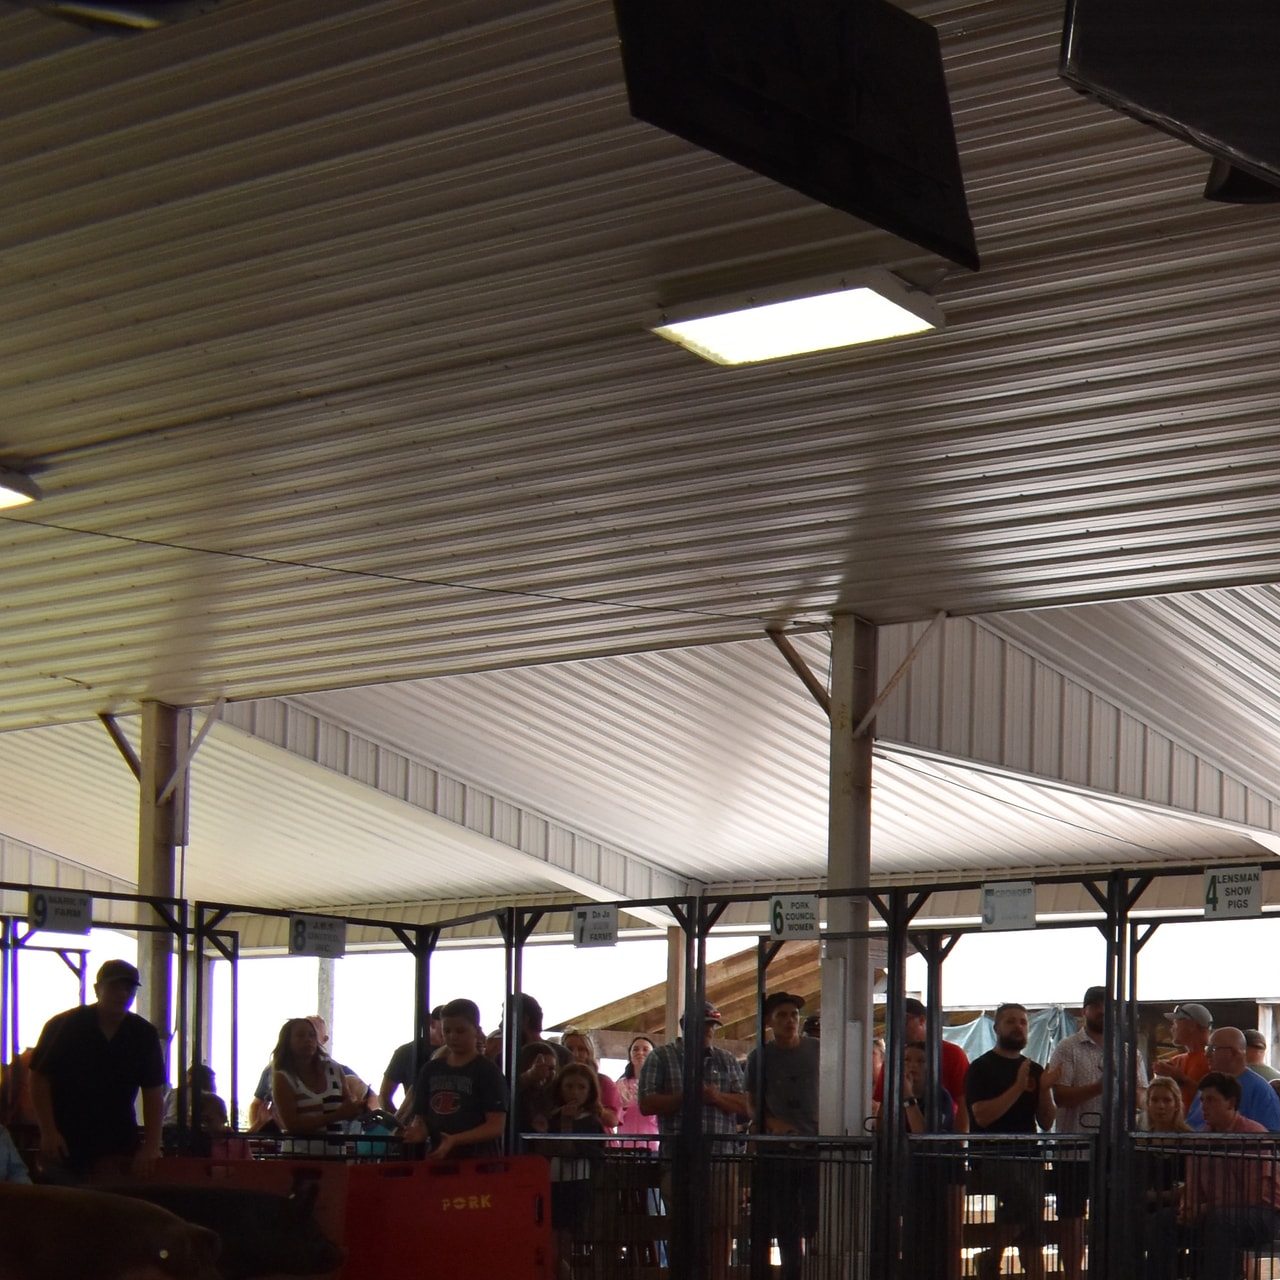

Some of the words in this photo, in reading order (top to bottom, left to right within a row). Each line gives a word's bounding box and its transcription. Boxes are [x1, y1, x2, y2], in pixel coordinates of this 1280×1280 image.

[1217, 872, 1260, 884] LENSMAN
[1206, 875, 1218, 911] 4
[1225, 886, 1252, 897] SHOW
[33, 894, 47, 928] 9
[1228, 899, 1249, 909] PIGS
[55, 908, 81, 918] FARM
[773, 900, 784, 935] 6
[785, 912, 816, 921] COUNCIL
[577, 911, 587, 943] 7
[788, 923, 814, 931] WOMEN
[294, 919, 305, 951] 8
[442, 1193, 492, 1212] PORK
